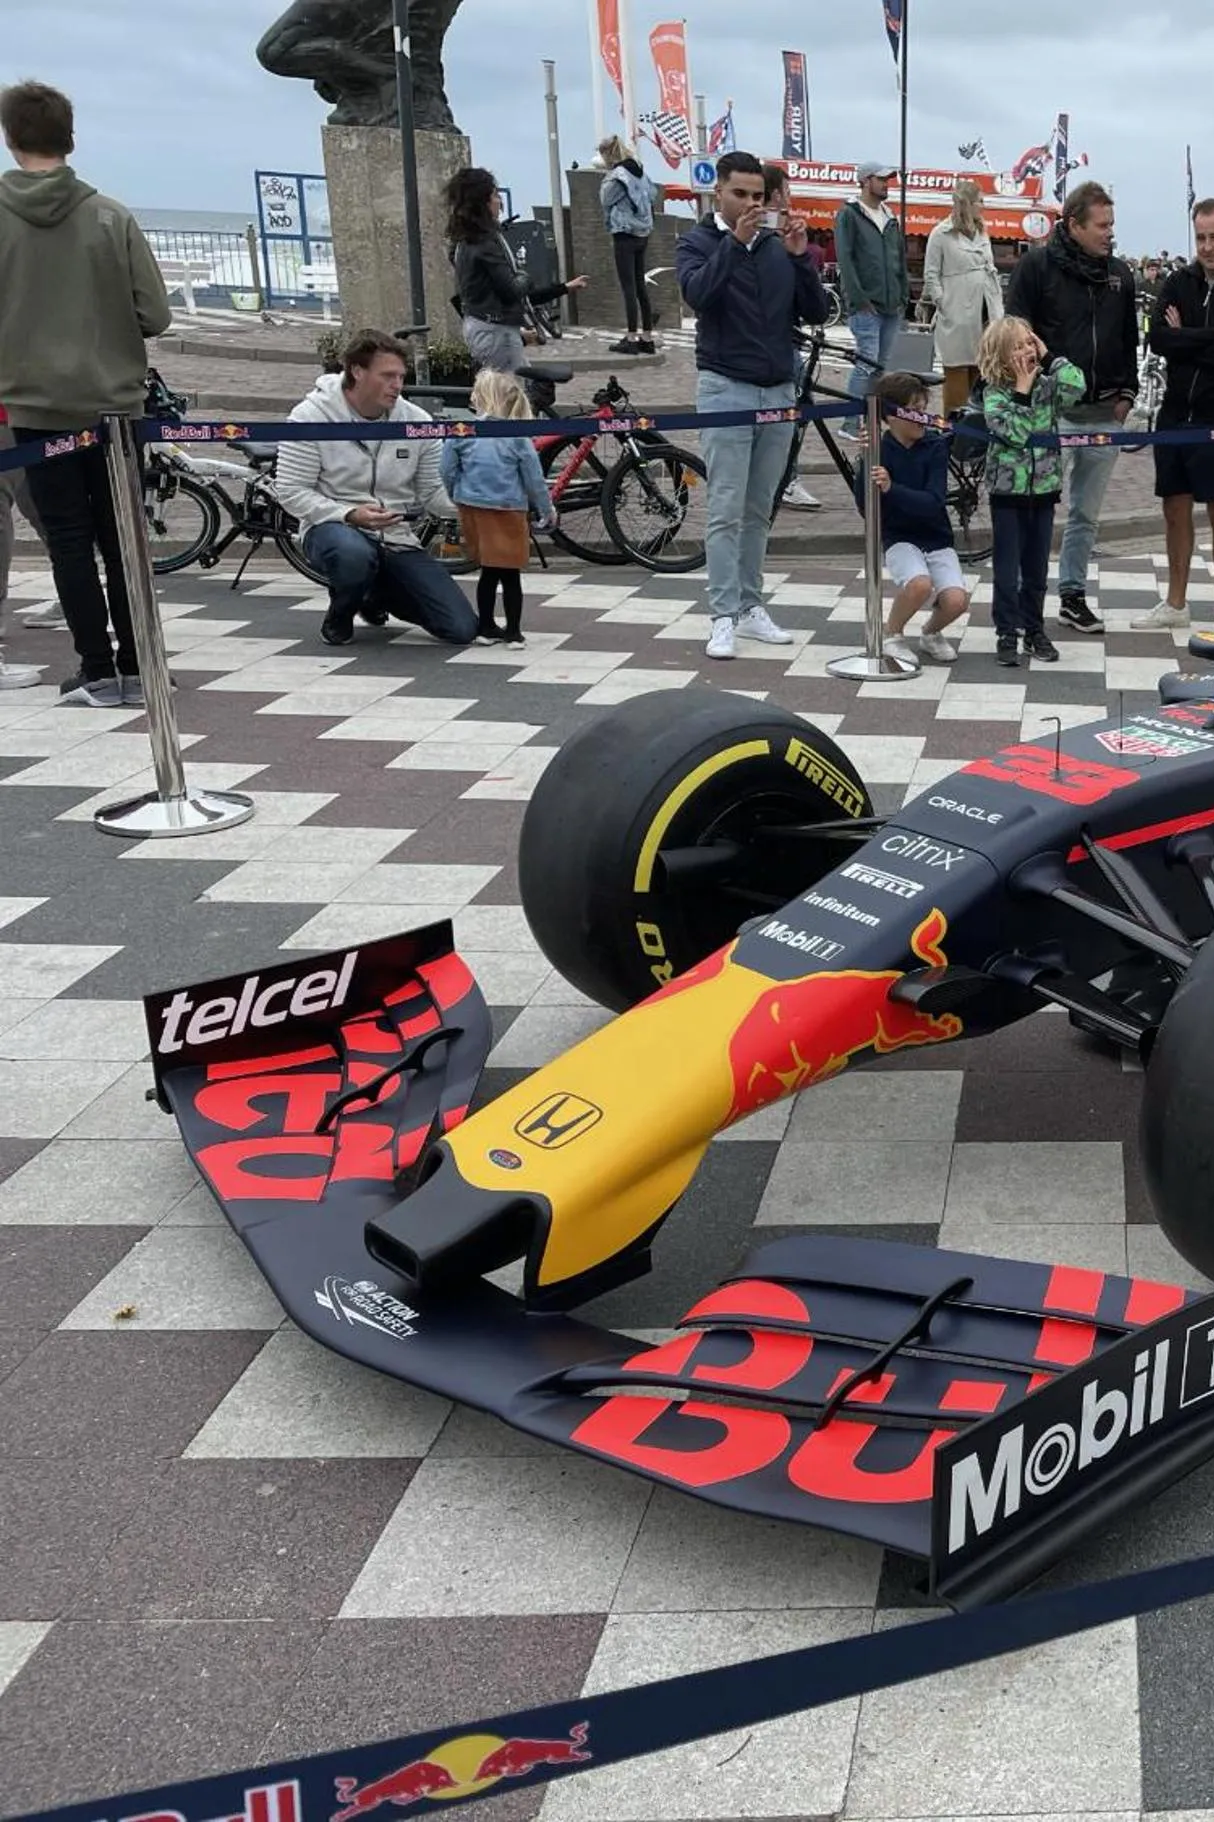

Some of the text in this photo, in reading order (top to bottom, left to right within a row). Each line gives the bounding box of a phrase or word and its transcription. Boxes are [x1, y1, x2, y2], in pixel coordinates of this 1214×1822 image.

[788, 163, 859, 182] Boudewi
[784, 738, 865, 818] PIRELLI
[928, 796, 1004, 824] ORACLE
[840, 863, 925, 898] PIRELLI
[804, 892, 881, 927] infinitum
[758, 919, 821, 953] Mobil
[157, 951, 359, 1054] telcel
[367, 1292, 419, 1320] ACTION
[948, 1339, 1169, 1554] Mobil
